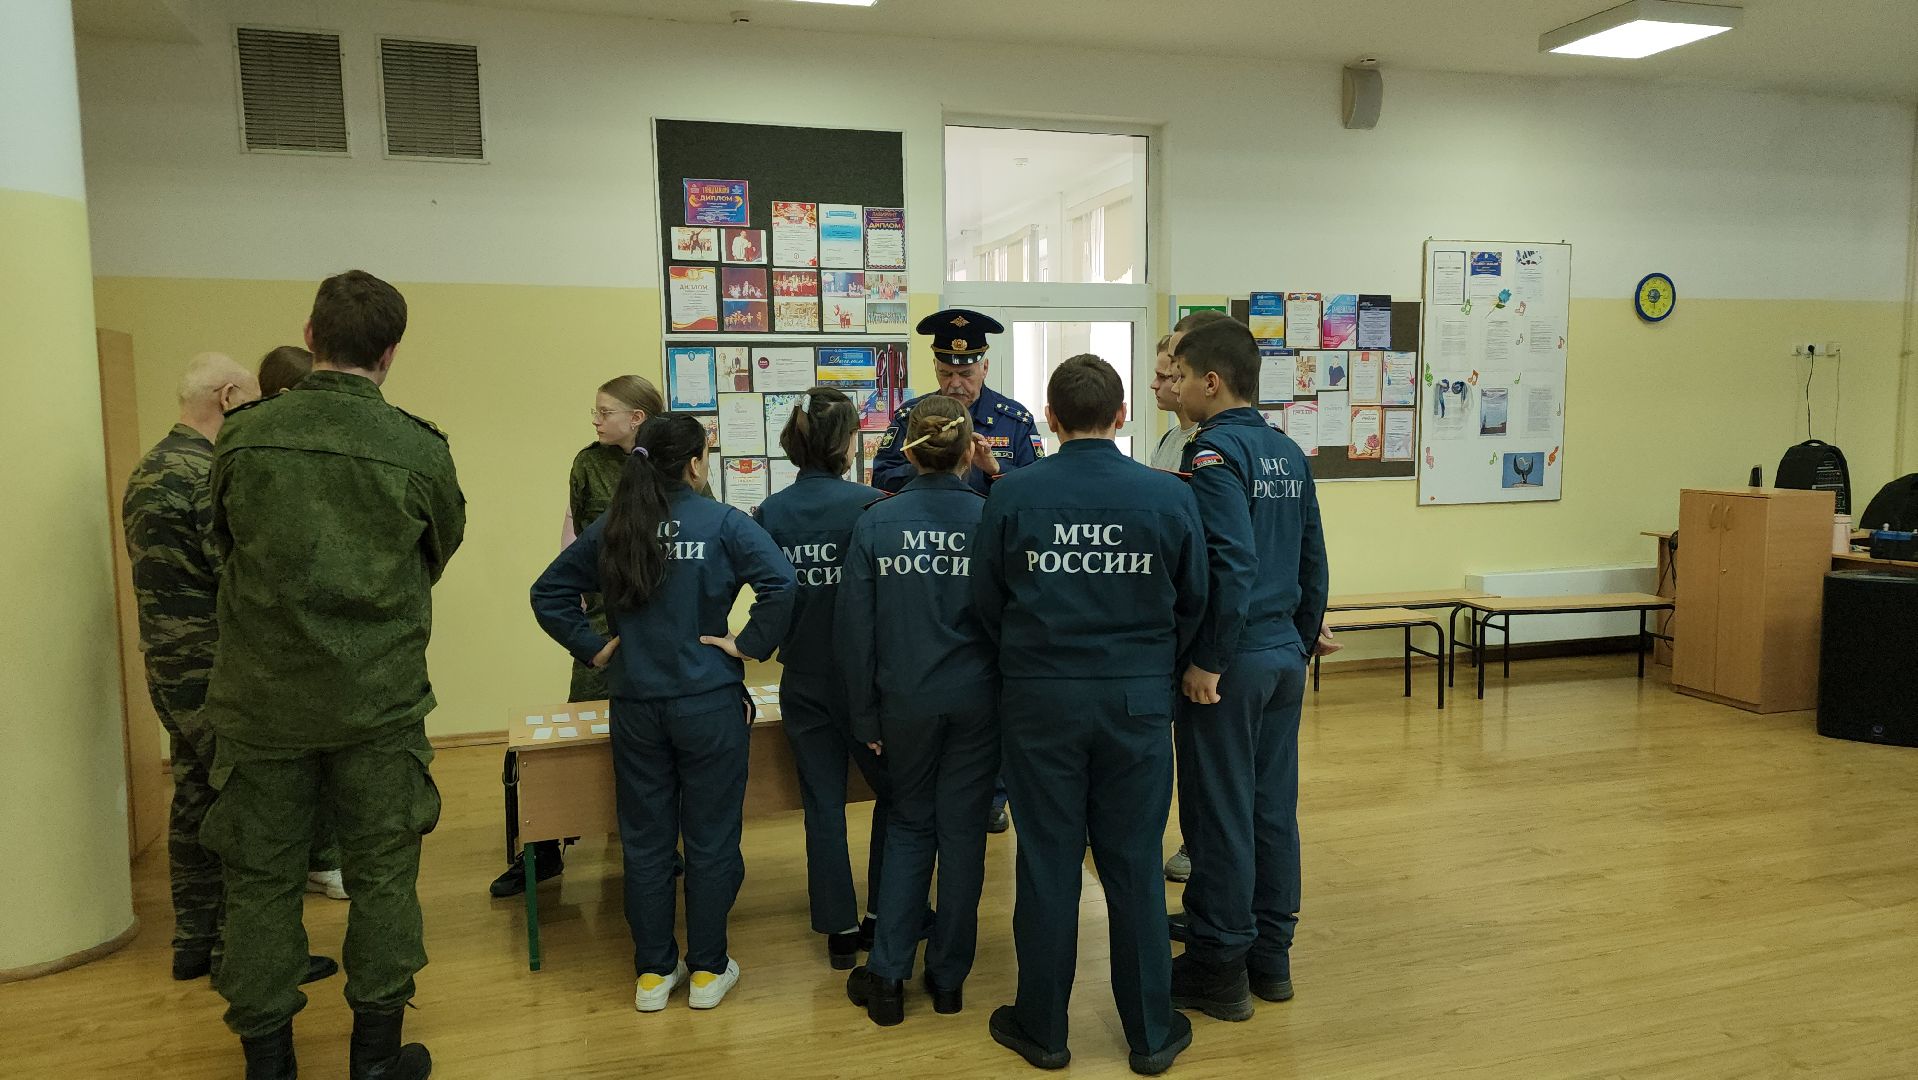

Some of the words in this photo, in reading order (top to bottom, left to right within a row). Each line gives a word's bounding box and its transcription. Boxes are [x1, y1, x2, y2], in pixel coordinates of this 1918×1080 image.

[1259, 457, 1290, 476] МЧС
[1251, 479, 1304, 499] РОССИИ
[901, 530, 966, 552] МЧС
[1052, 523, 1123, 546] МЧС
[782, 543, 837, 564] МЧС
[1025, 550, 1153, 575] РОССИИ
[795, 566, 842, 586] ССИ
[877, 554, 971, 577] РОССИ
